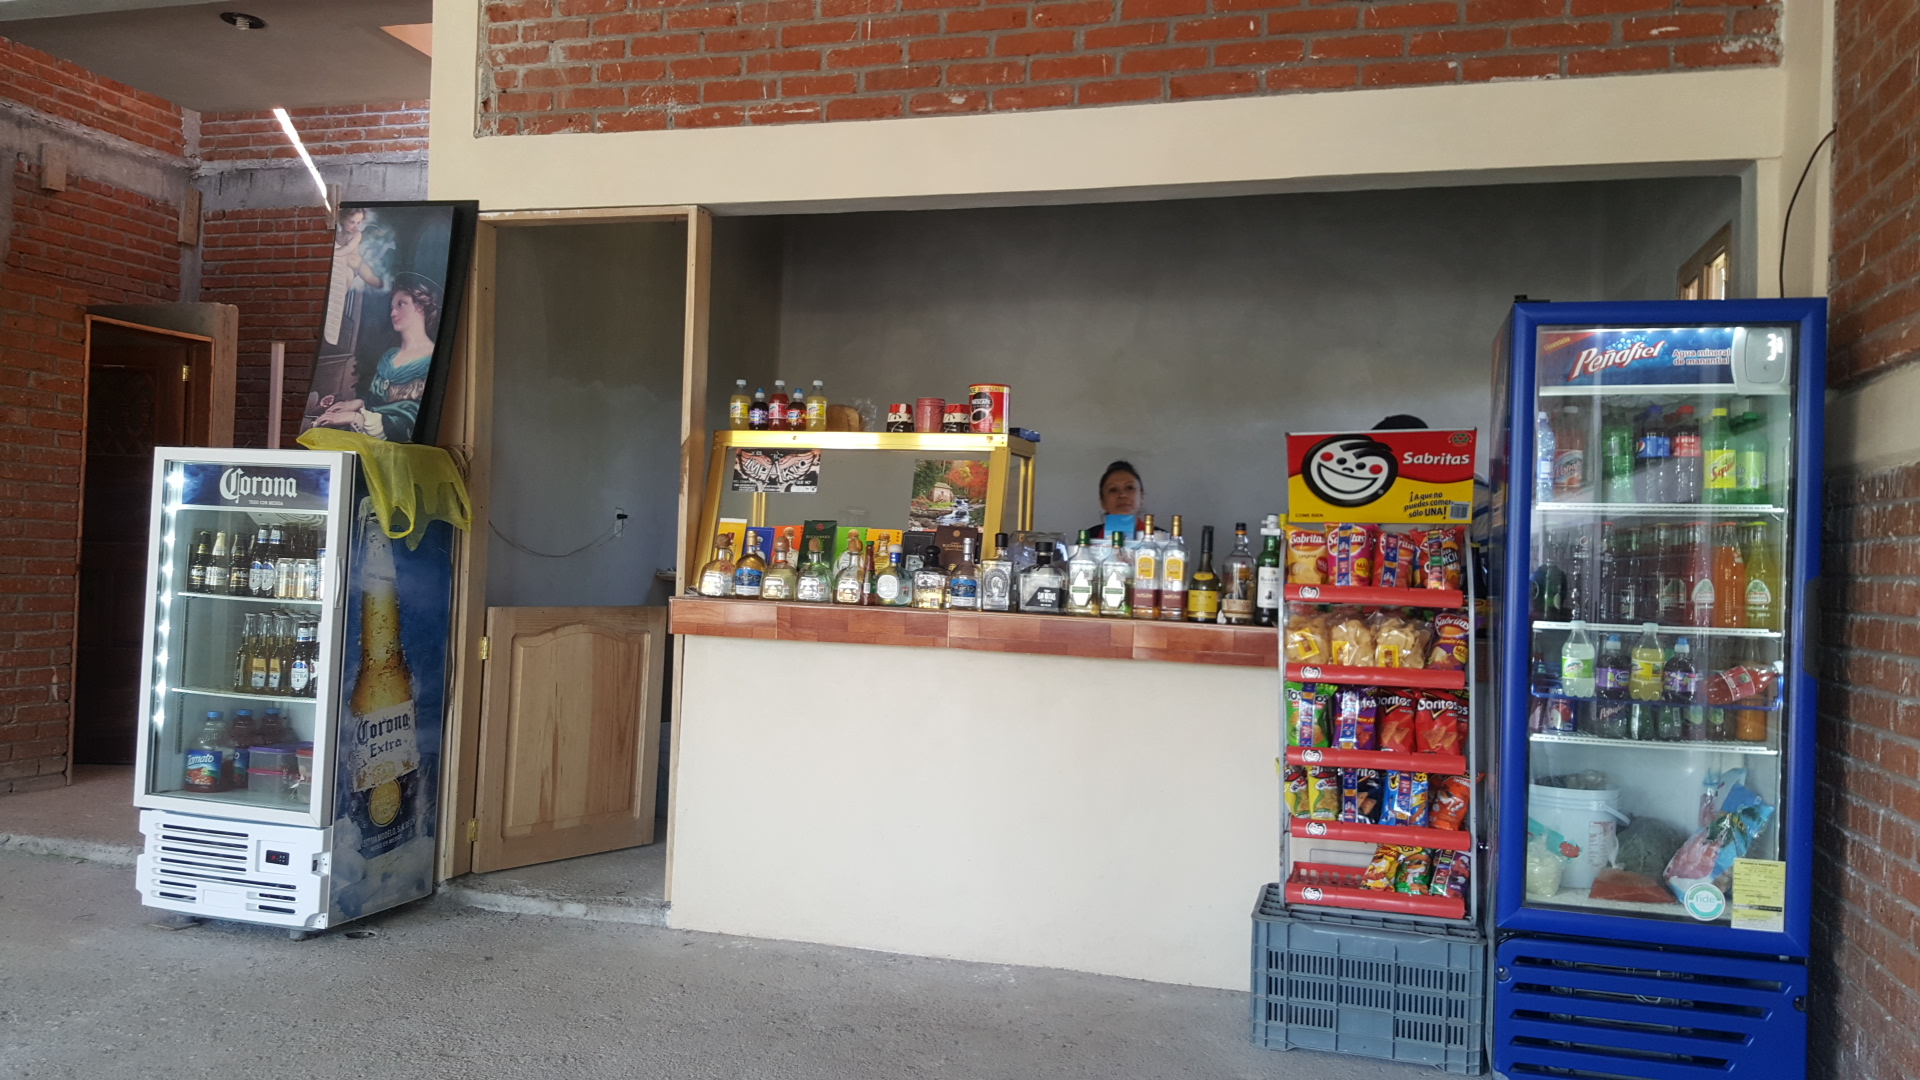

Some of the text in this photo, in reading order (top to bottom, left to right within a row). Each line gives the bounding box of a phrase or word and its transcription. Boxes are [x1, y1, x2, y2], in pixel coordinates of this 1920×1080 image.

[1568, 340, 1666, 380] Peñafiel
[1672, 348, 1731, 359] Agua mineral
[1673, 357, 1730, 365] de manantial
[1402, 451, 1471, 466] Sabritas
[219, 467, 298, 504] Corona
[356, 712, 411, 746] Corona
[369, 737, 403, 759] Extra
